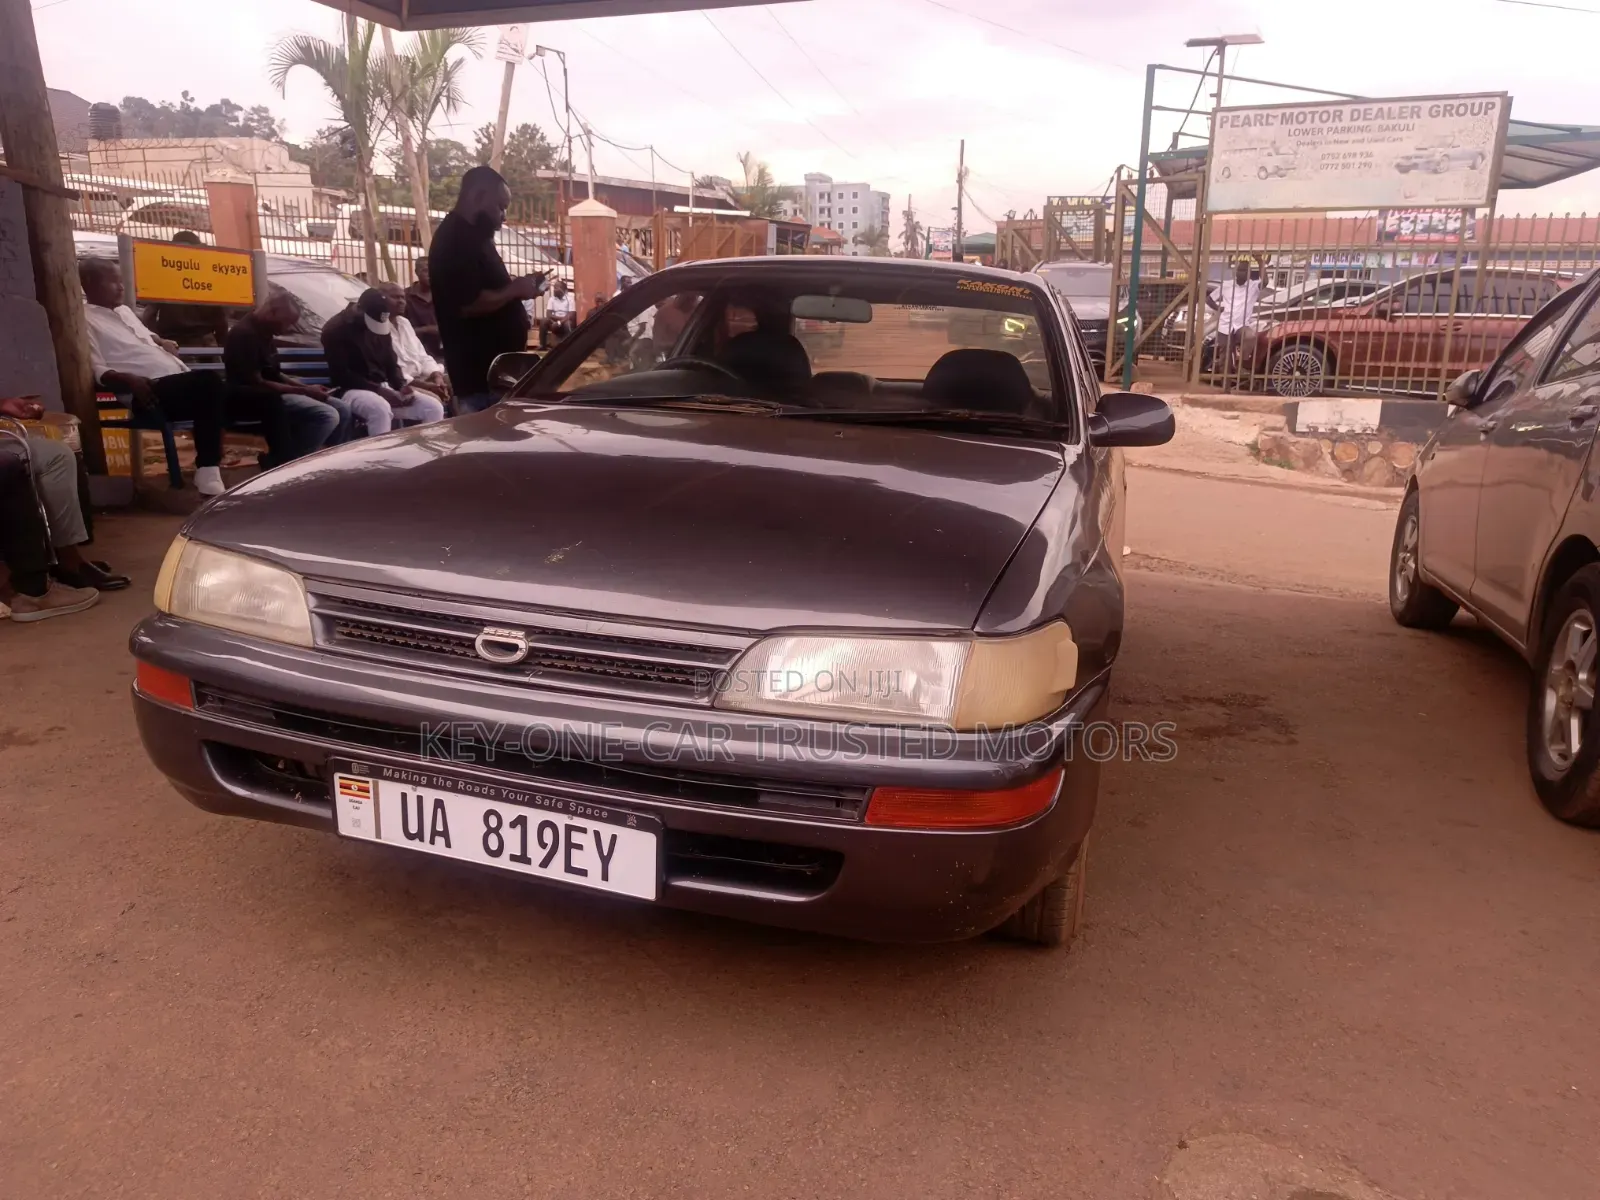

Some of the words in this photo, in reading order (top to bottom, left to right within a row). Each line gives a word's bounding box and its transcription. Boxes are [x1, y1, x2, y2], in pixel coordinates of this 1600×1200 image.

[1219, 113, 1275, 129] PEARL
[1280, 109, 1344, 126] MOTOR
[1350, 105, 1422, 122] DEALER
[1428, 101, 1496, 118] GROUP
[1287, 127, 1324, 137] LOWER
[1326, 125, 1372, 135] PARKING
[1377, 123, 1415, 133] BAKULI
[1320, 162, 1339, 170] 0772
[1357, 161, 1373, 169] 290
[161, 256, 200, 271] bugulu
[212, 263, 247, 275] ekyaya
[182, 277, 213, 291] Close
[382, 767, 428, 785] Making
[432, 776, 453, 788] the
[457, 780, 496, 796] Roads
[501, 788, 530, 802] Your
[534, 795, 563, 809] Safe
[569, 801, 609, 818] Space
[400, 790, 452, 849] UA
[482, 808, 618, 882] 819EY
